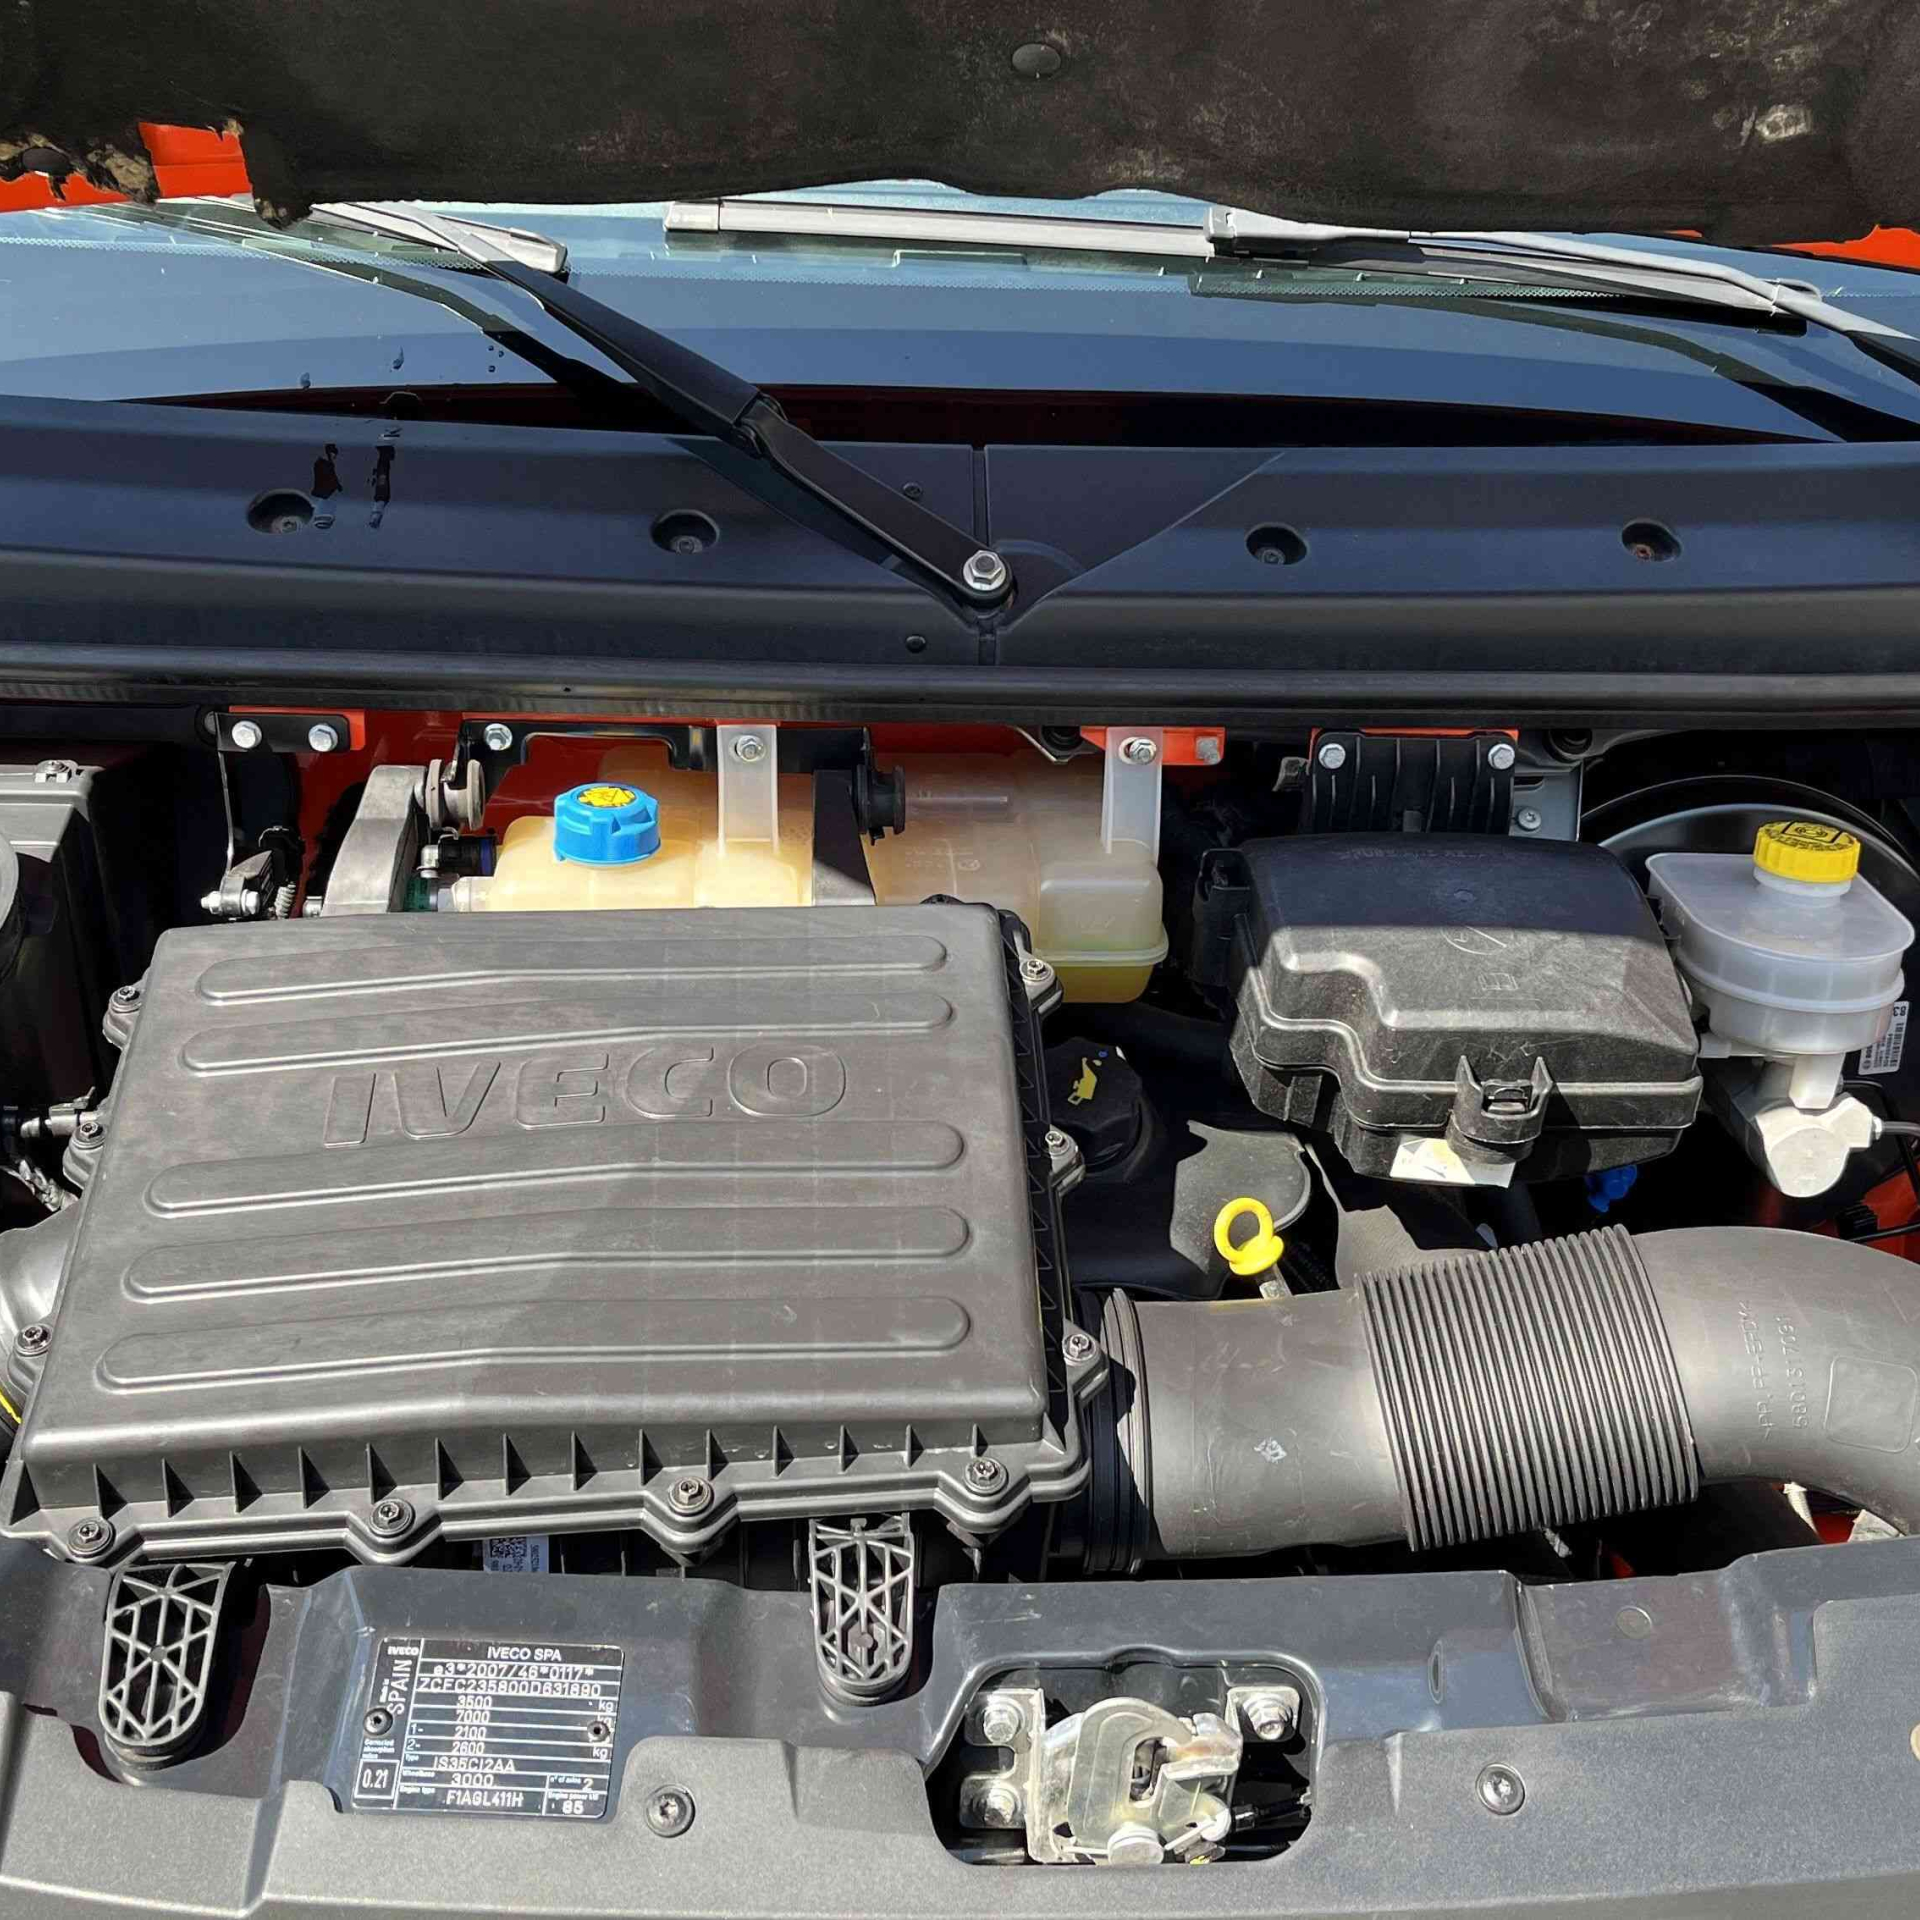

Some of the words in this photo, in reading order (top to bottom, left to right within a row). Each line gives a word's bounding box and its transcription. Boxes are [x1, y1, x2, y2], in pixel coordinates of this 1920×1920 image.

[322, 1044, 848, 1148] IVECO
[388, 1646, 419, 1656] IVECO
[487, 1646, 531, 1660] IVECO
[534, 1648, 562, 1661] SPA
[386, 1659, 413, 1715] SPAIN
[456, 1694, 493, 1708] 3500
[599, 1700, 614, 1713] kg
[455, 1709, 491, 1724] 7000
[454, 1725, 487, 1740] 2100
[451, 1741, 485, 1756] 2600
[593, 1747, 608, 1761] kg
[362, 1768, 389, 1789] 0.21
[582, 1777, 594, 1792] 2
[562, 1800, 584, 1815] 85
